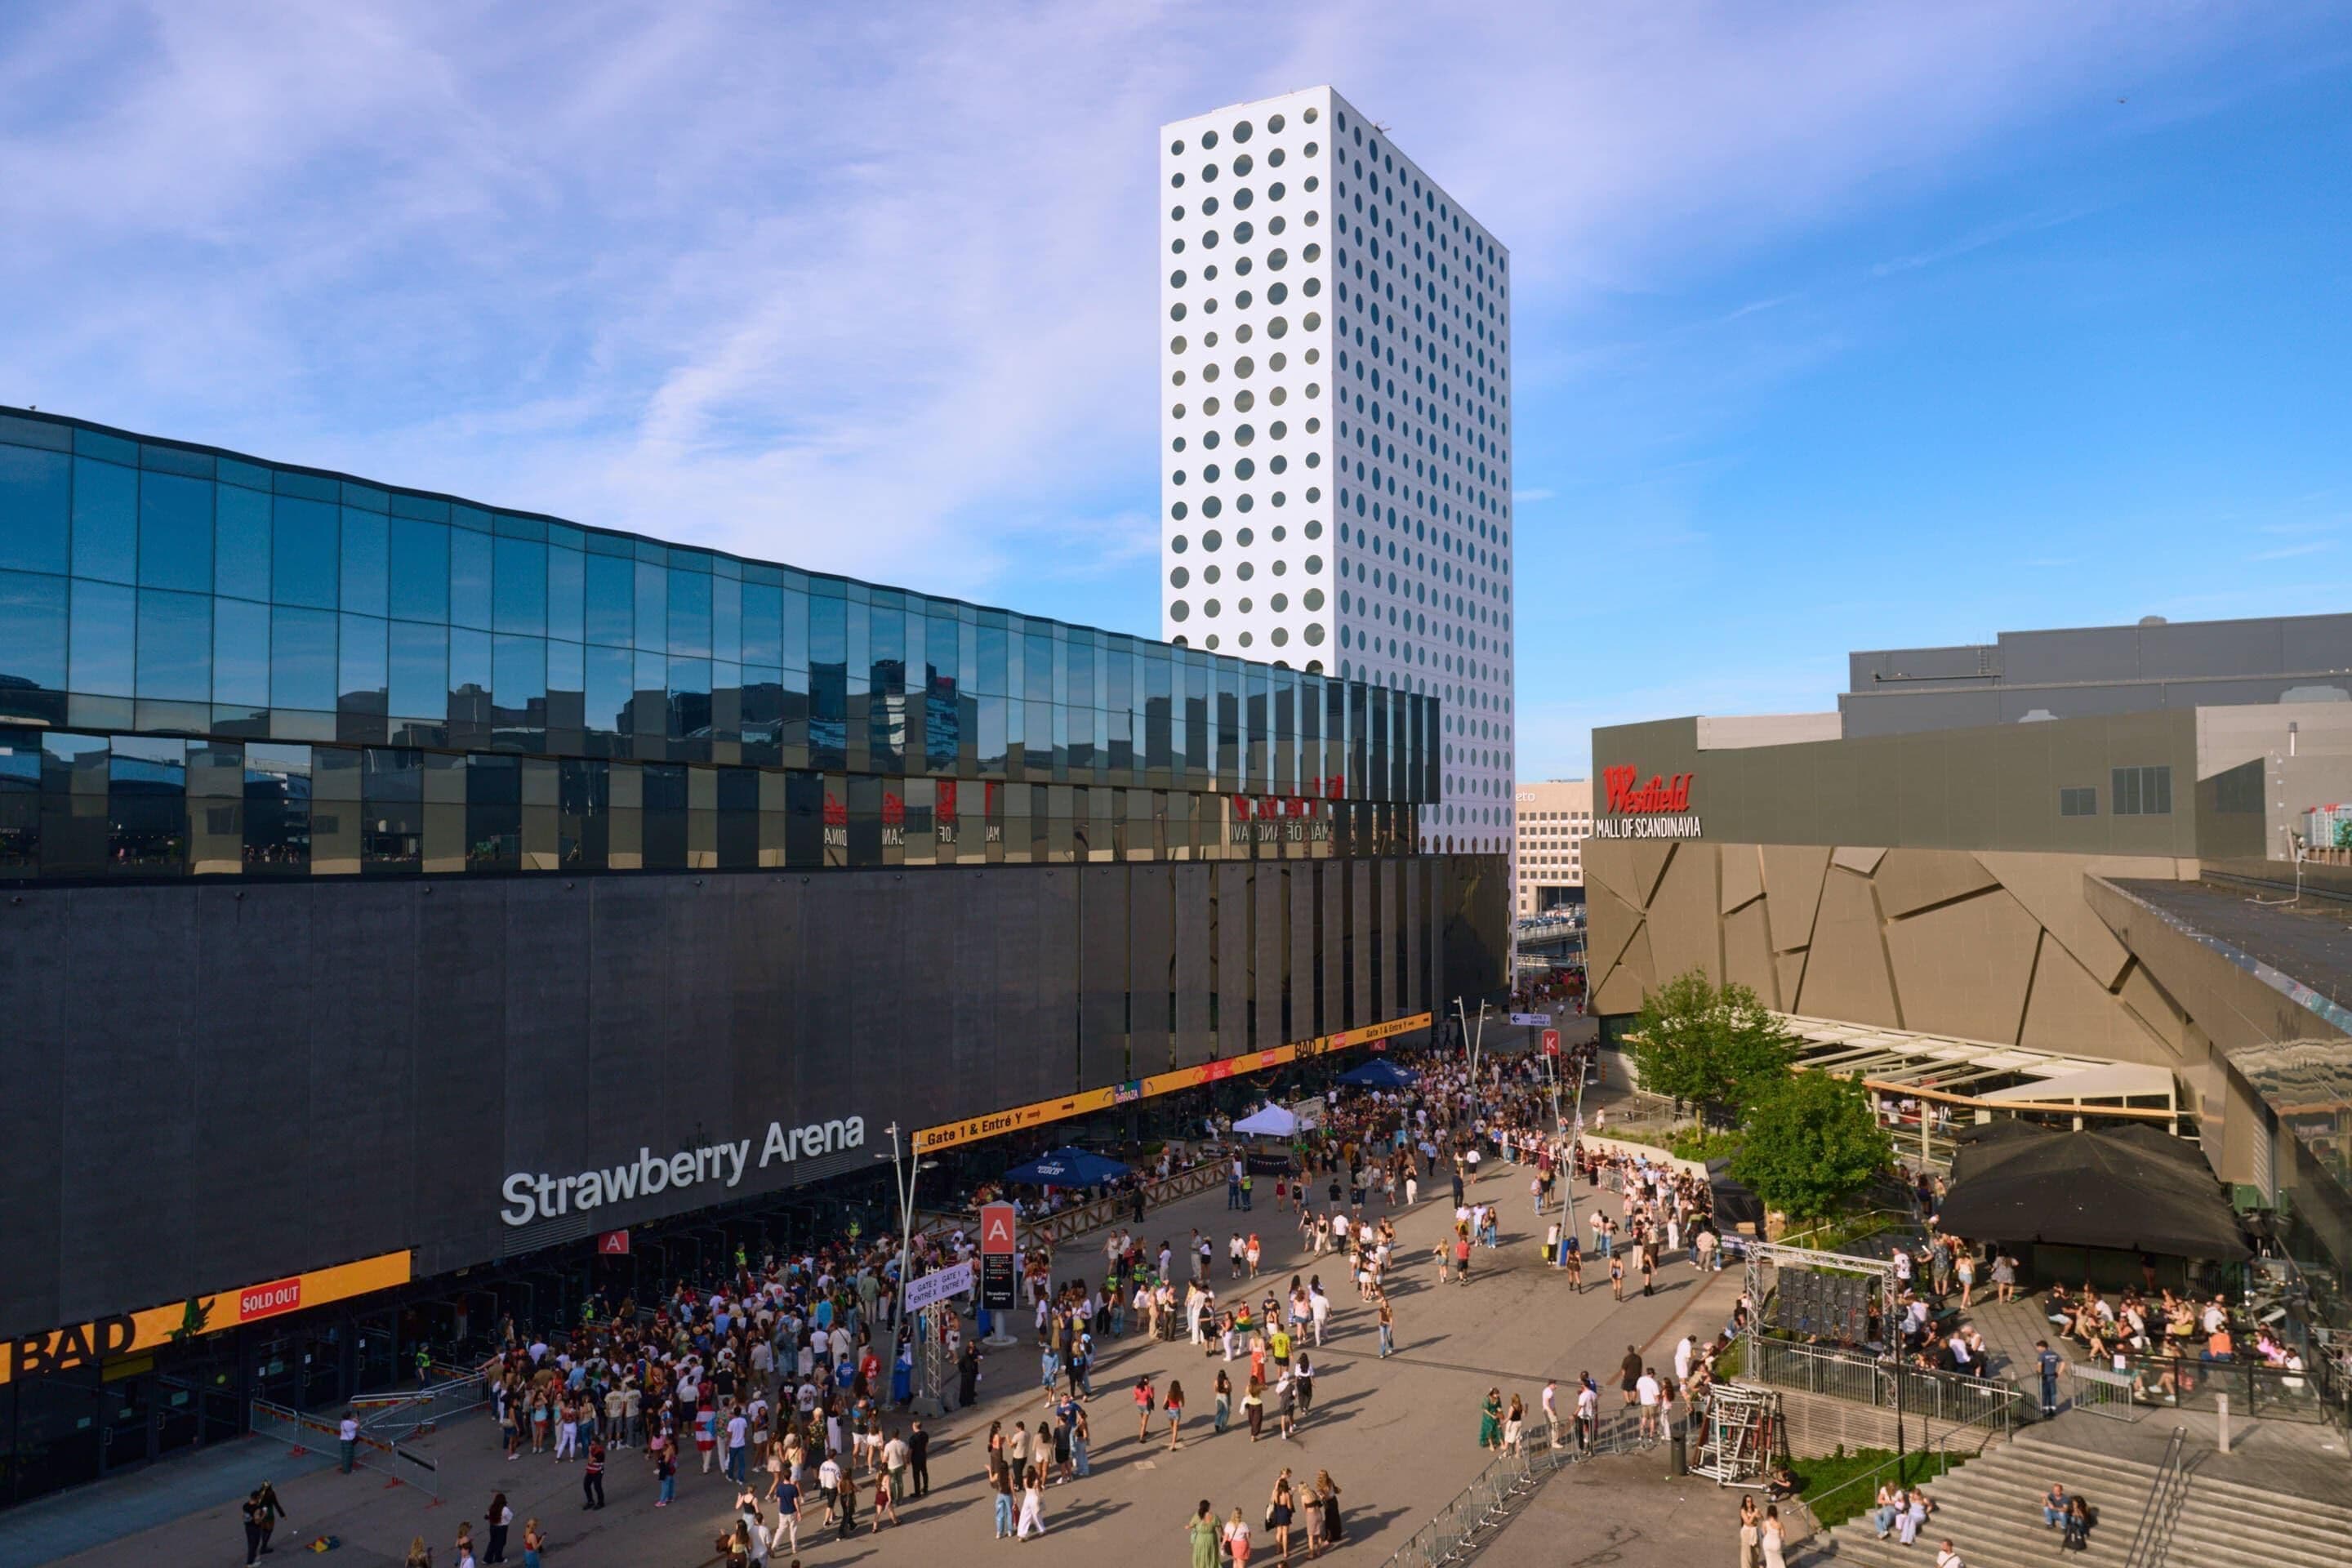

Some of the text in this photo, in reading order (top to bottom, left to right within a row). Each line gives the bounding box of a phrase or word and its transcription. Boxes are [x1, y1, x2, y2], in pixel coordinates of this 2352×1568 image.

[1602, 764, 1695, 814] Westfield
[1597, 816, 1702, 839] MALL OF SCANDINAVIA
[1374, 1041, 1382, 1049] K
[1547, 1037, 1555, 1049] K
[928, 1111, 1022, 1145] Gate 1 & Entré Y
[501, 1115, 864, 1226] Strawberry Arena
[988, 1219, 1008, 1241] A
[607, 1236, 621, 1251] A
[917, 1279, 938, 1293] GATE 2
[942, 1272, 957, 1283] GATE
[942, 1281, 960, 1293] ENTRÉ
[242, 1285, 299, 1314] SOLD OUT
[913, 1291, 933, 1303] ENTRÉ
[10, 1312, 136, 1382] BAD
